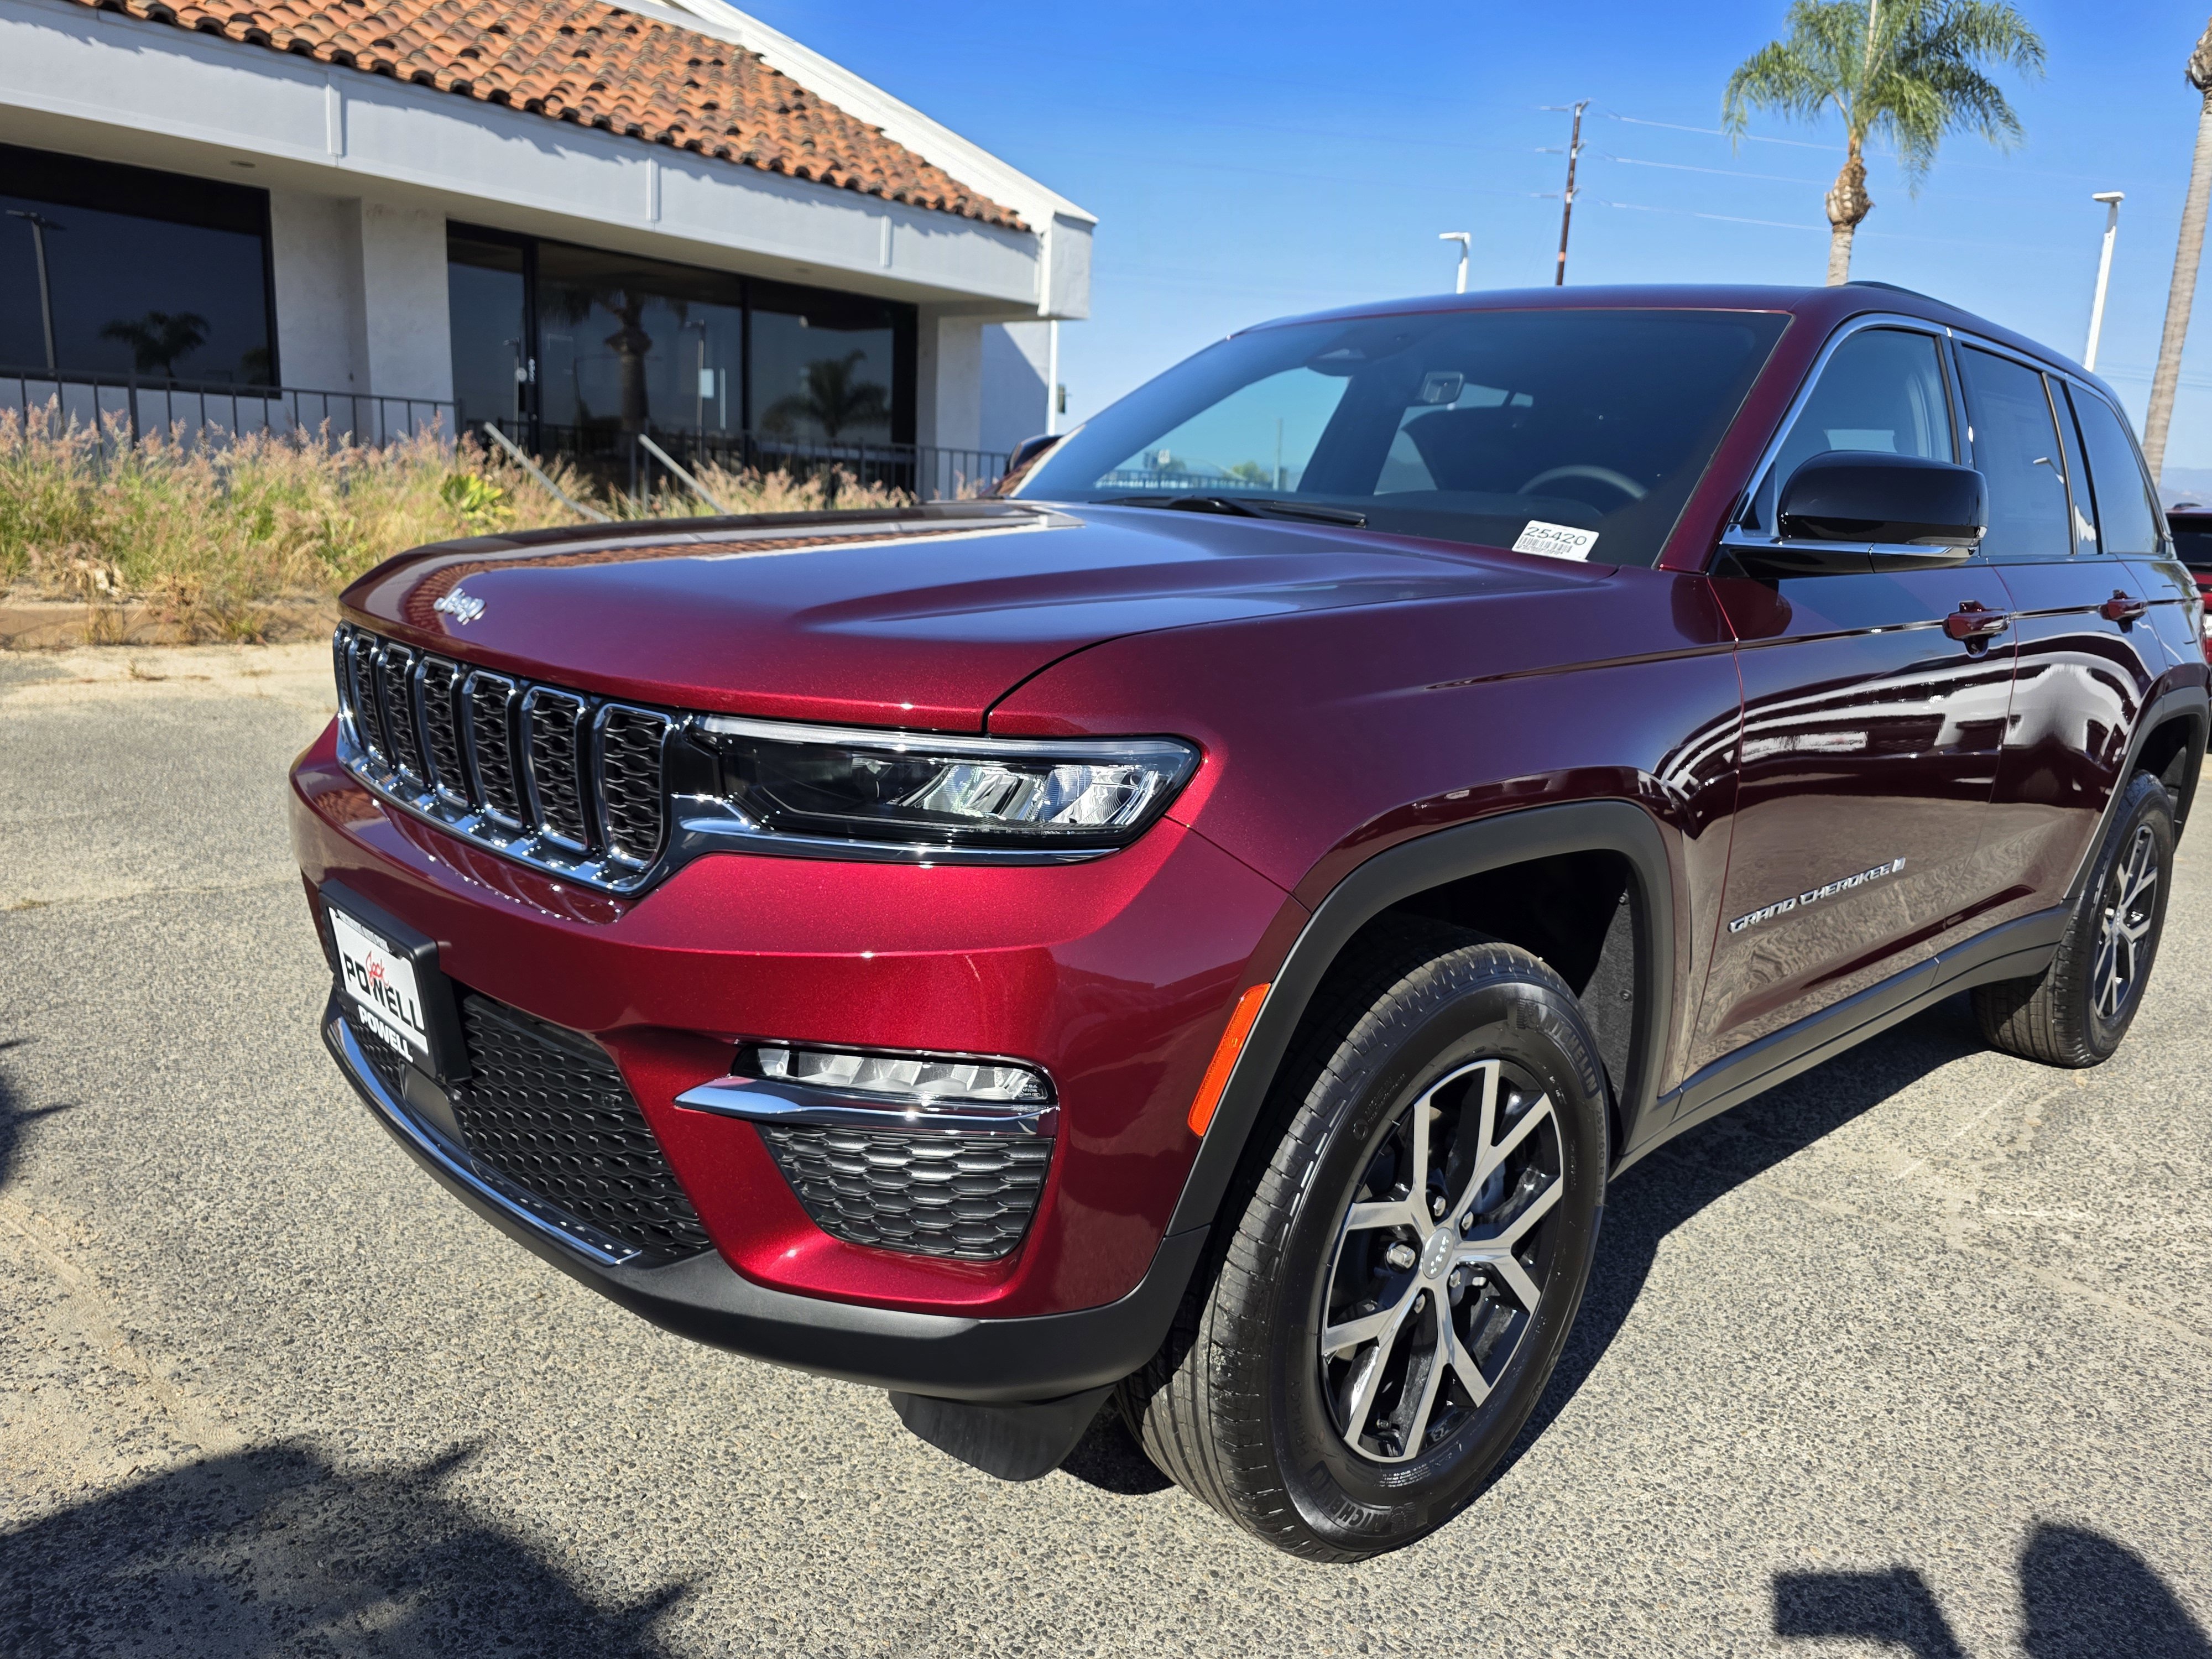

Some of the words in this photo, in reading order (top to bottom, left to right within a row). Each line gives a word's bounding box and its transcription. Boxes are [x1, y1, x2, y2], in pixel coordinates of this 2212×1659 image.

[1524, 526, 1588, 546] 25420
[433, 587, 486, 623] Jeep
[1728, 897, 1797, 933] GRAND
[1798, 862, 1891, 905] CHEROKEE
[358, 1004, 414, 1063] POWELL
[1540, 1014, 1599, 1094] MICHELIN
[1290, 1380, 1309, 1457] PRIMACY
